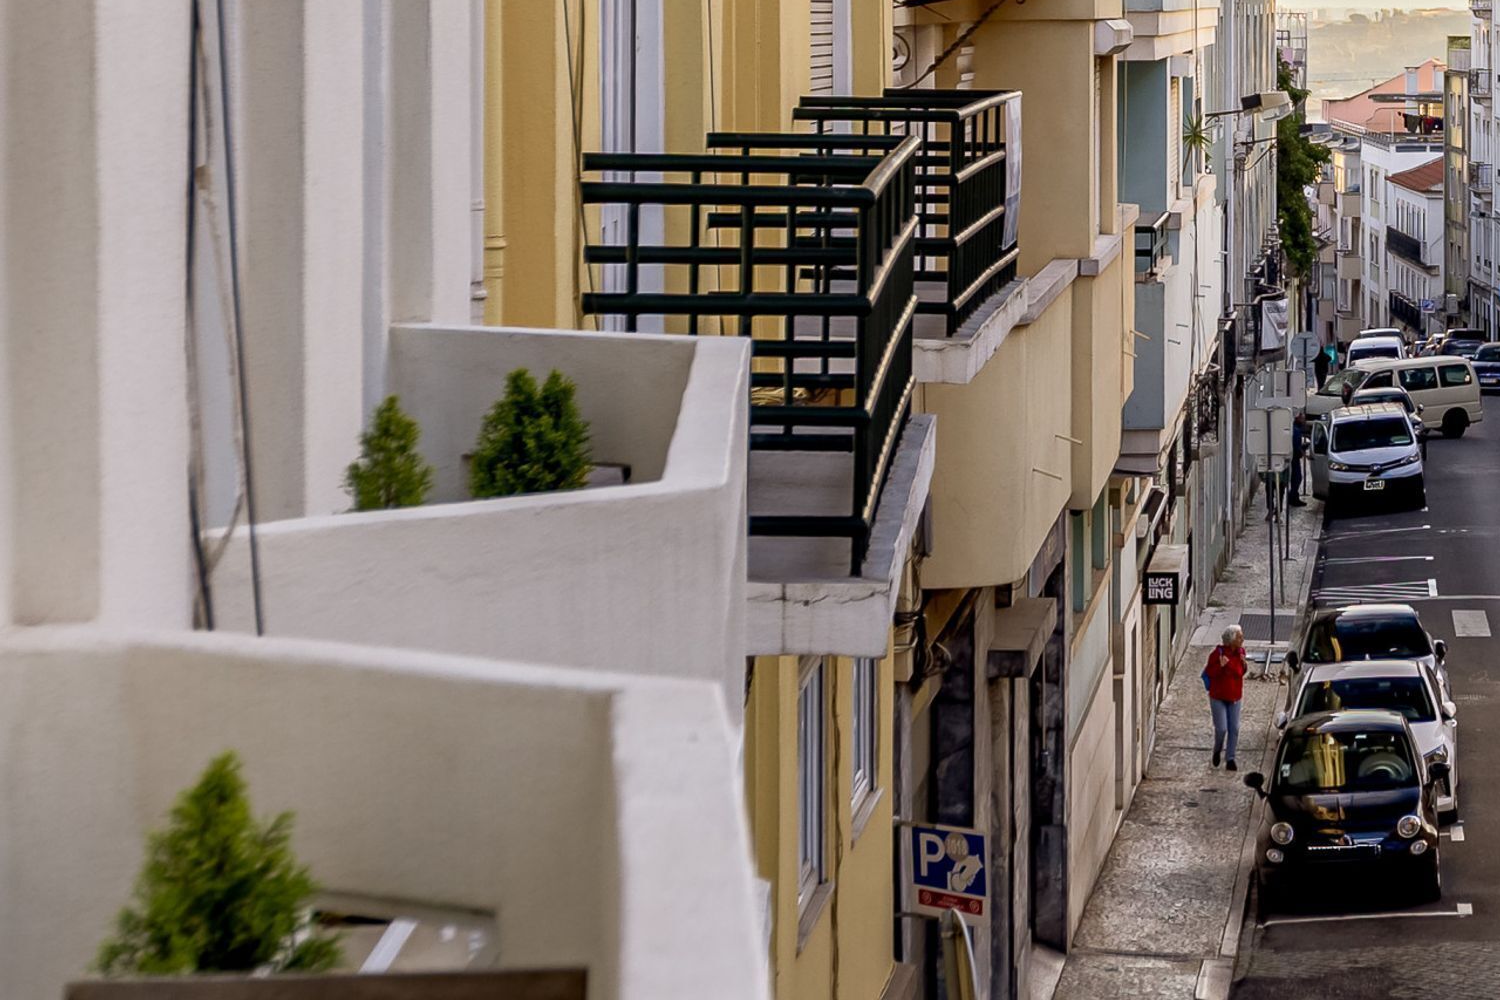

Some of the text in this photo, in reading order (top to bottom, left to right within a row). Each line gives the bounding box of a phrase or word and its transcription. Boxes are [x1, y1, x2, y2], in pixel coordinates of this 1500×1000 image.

[1148, 577, 1173, 587] LUCK
[1148, 587, 1174, 599] LING
[919, 832, 946, 877] P
